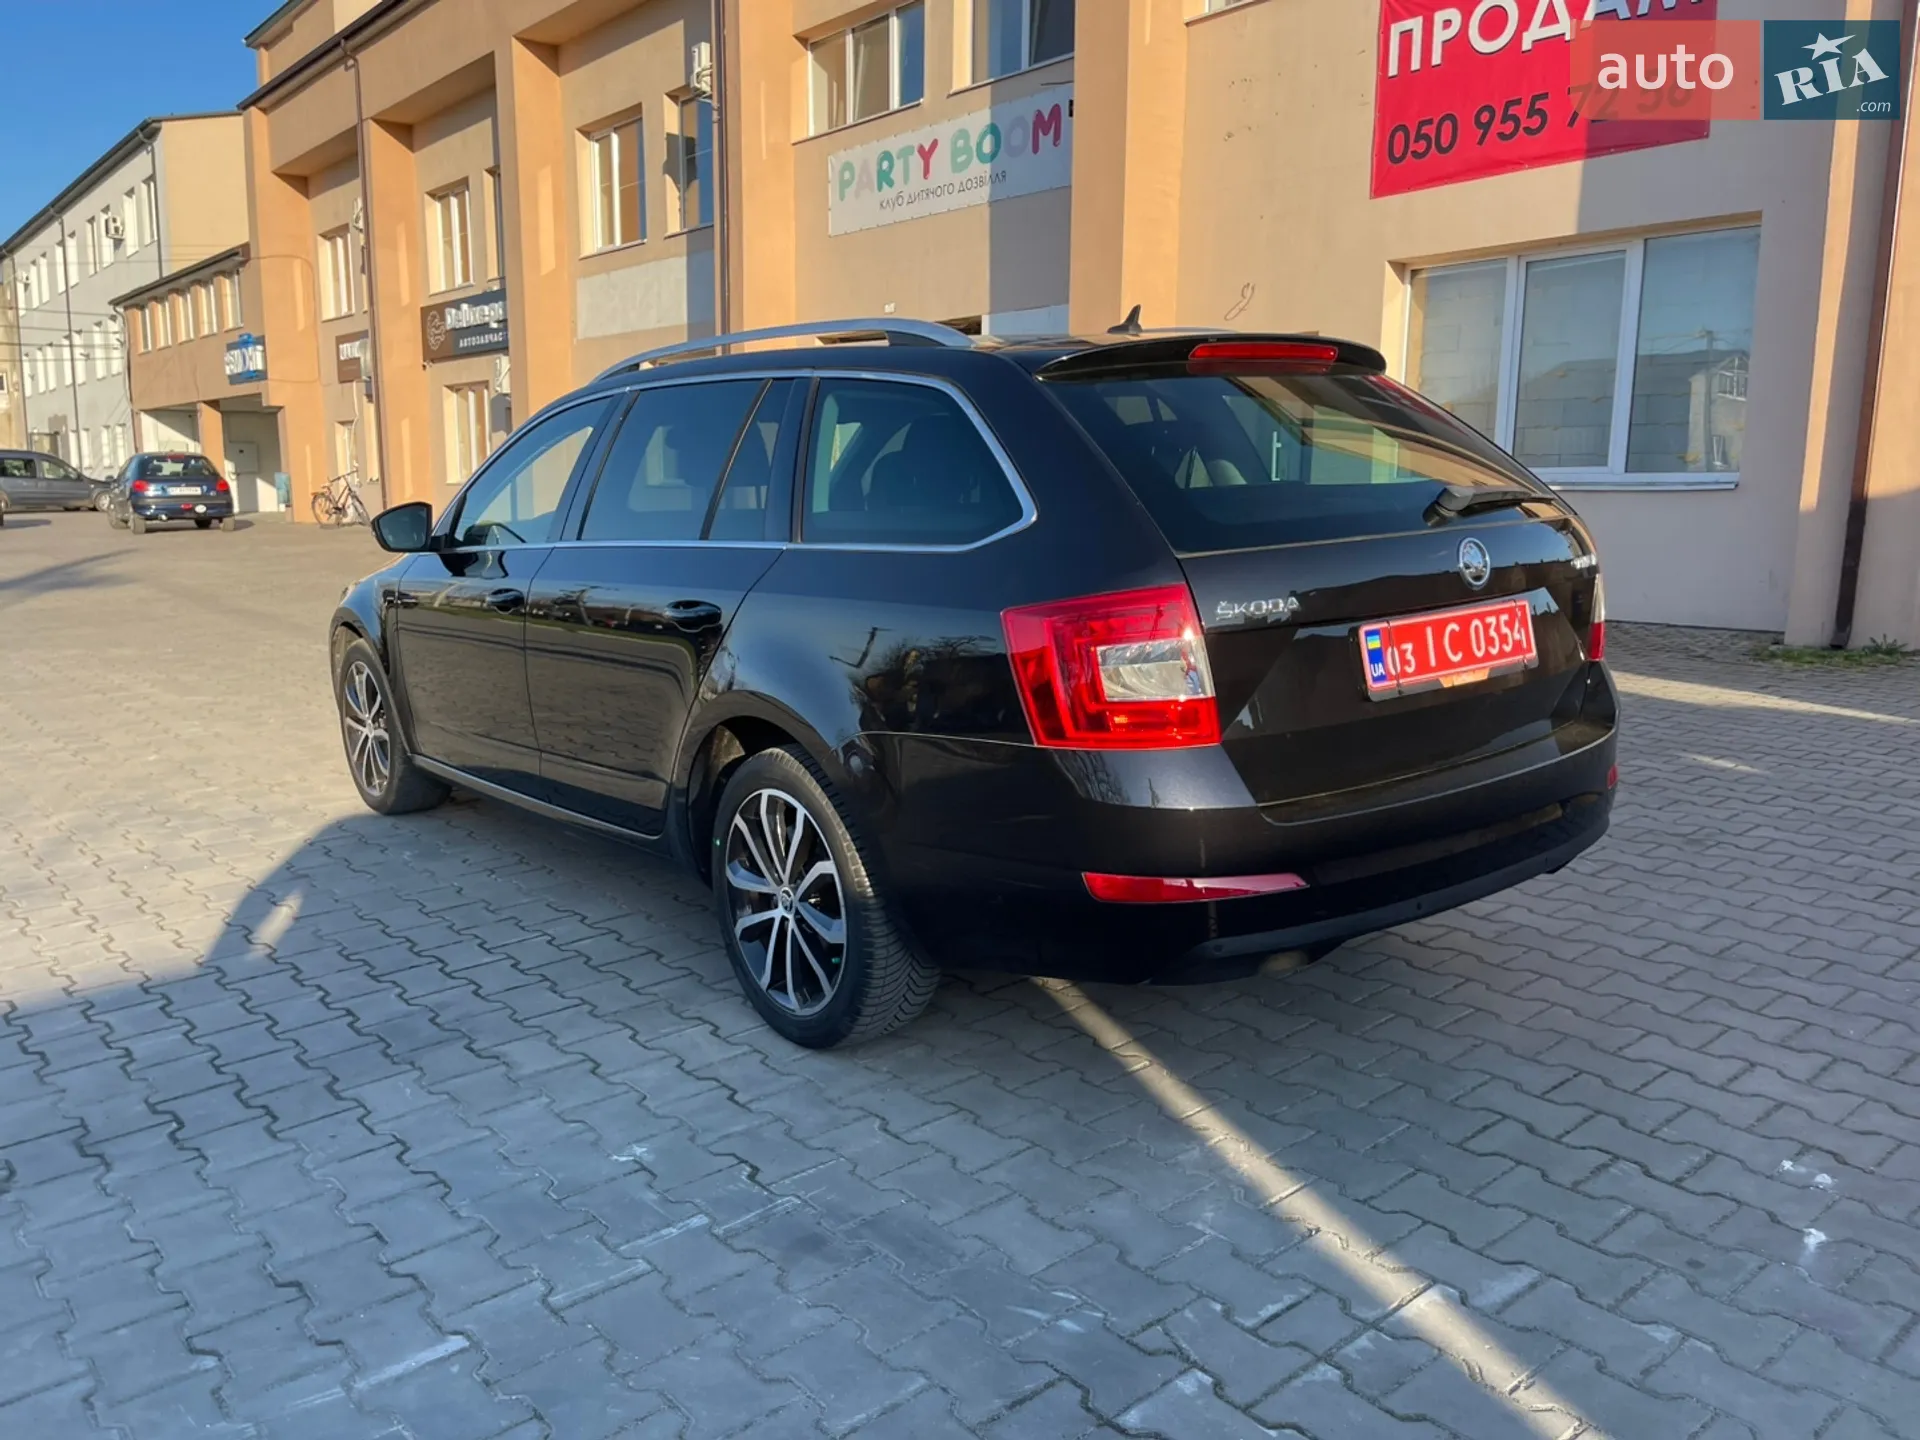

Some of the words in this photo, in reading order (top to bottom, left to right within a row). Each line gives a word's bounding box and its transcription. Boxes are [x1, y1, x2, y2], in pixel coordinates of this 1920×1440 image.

[838, 138, 939, 201] PARTY
[950, 103, 1062, 174] BOOM
[1387, 113, 1459, 165] 050
[1473, 92, 1550, 147] 955
[879, 191, 904, 211] клуб
[906, 183, 955, 205] дитячого
[957, 170, 1007, 193] дозвілля
[1216, 596, 1300, 621] ŠKODA
[1387, 642, 1416, 676] 03
[1469, 607, 1528, 658] 0354
[1371, 662, 1386, 678] UA
